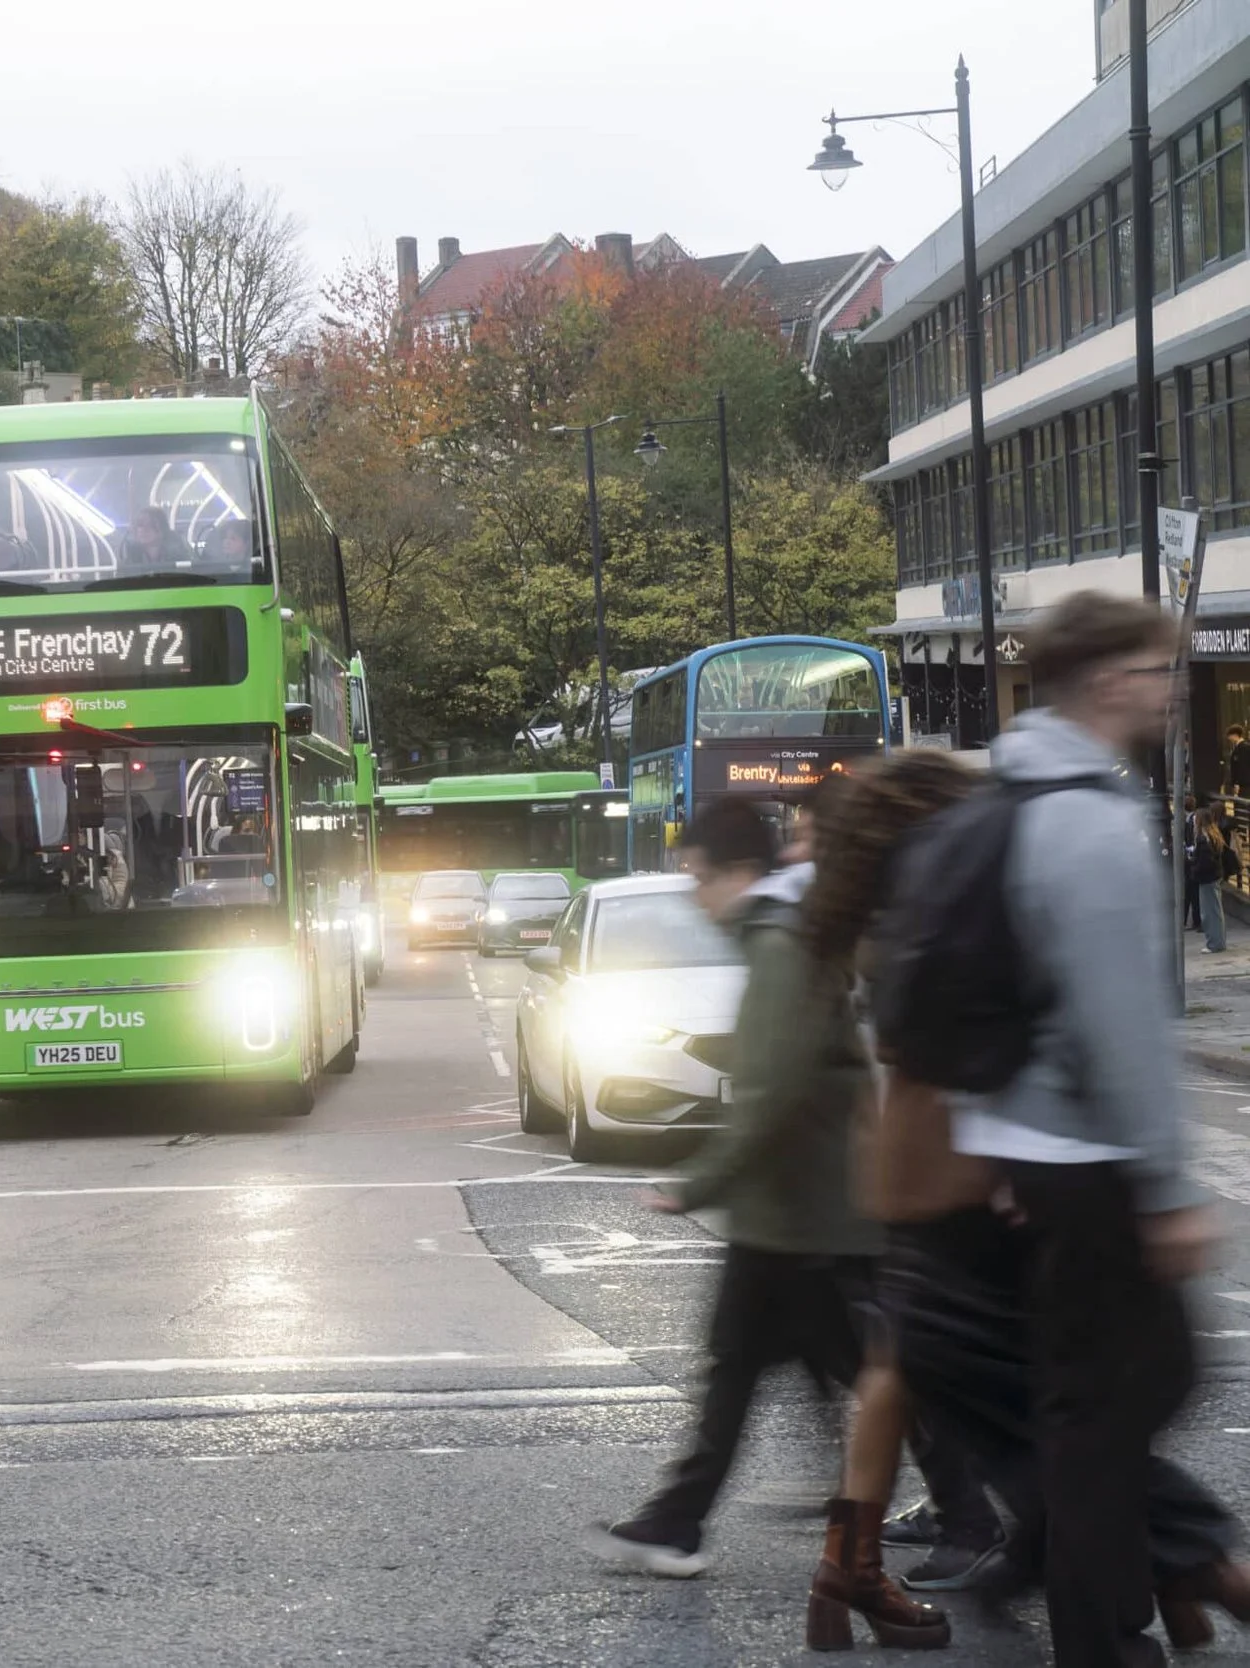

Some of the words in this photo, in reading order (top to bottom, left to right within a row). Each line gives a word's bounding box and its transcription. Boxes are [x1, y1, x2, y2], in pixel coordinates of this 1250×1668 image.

[14, 625, 134, 661] Frenchay
[139, 623, 184, 666] 72
[1226, 628, 1250, 652] PLANET
[5, 658, 37, 676] City
[40, 657, 95, 673] Centre
[75, 699, 102, 711] first
[104, 698, 127, 710] bus
[781, 751, 796, 759] City
[730, 764, 778, 783] Brentry
[5, 1005, 98, 1032] WEST
[100, 1005, 146, 1028] bus
[38, 1047, 81, 1064] YH25
[86, 1046, 116, 1062] DEU
